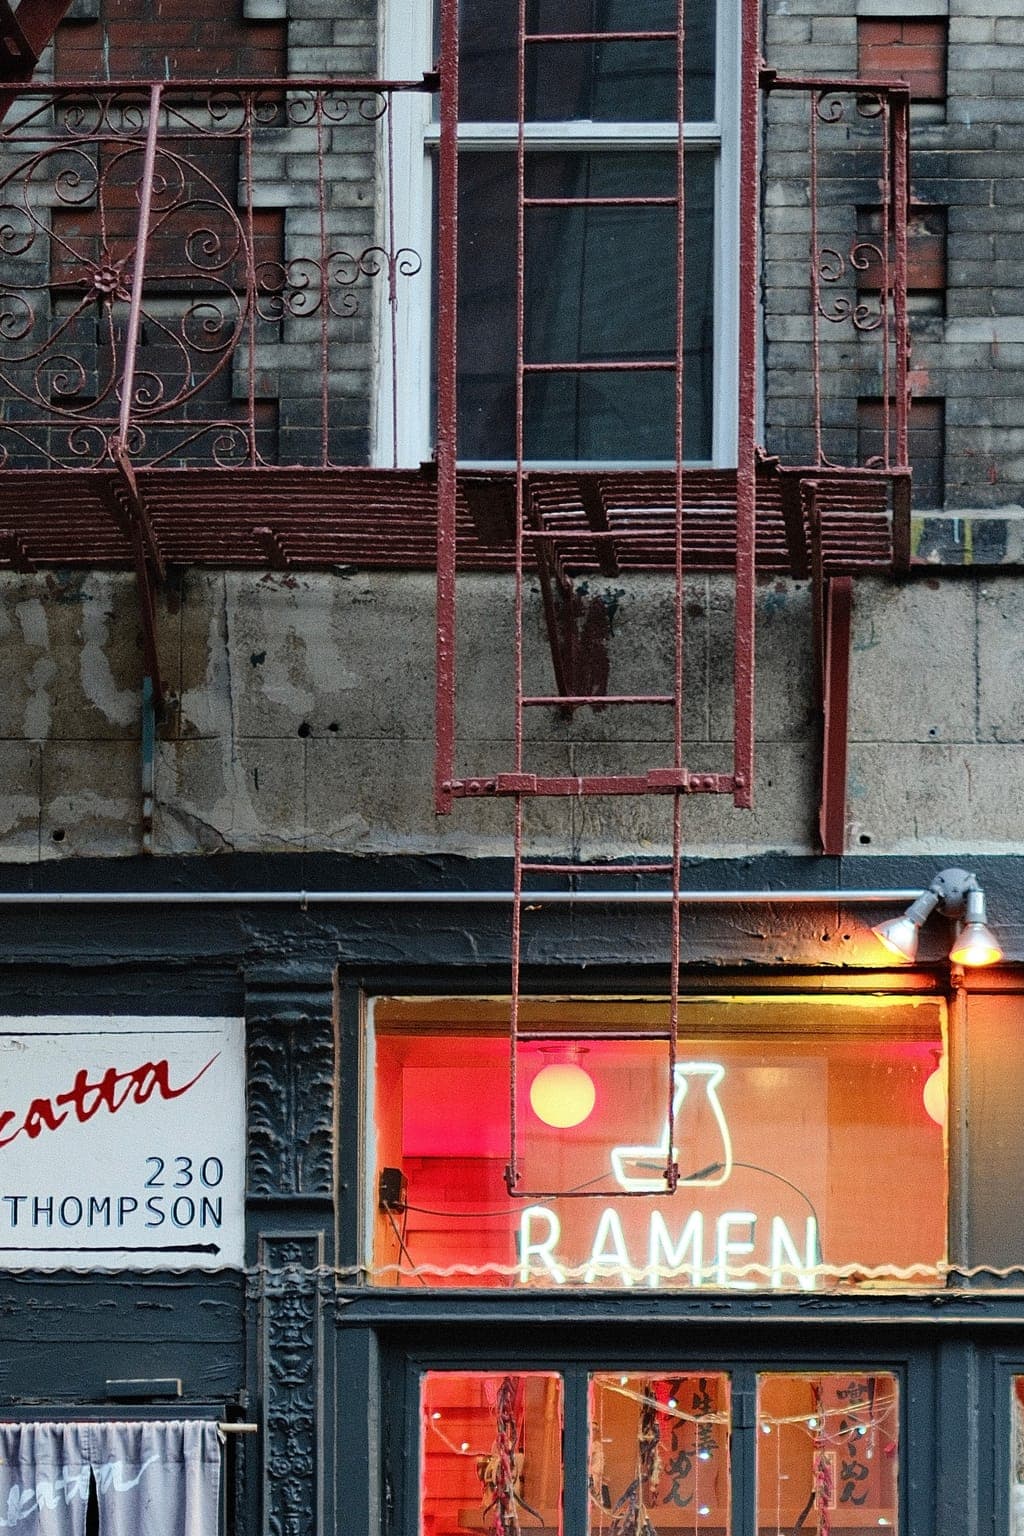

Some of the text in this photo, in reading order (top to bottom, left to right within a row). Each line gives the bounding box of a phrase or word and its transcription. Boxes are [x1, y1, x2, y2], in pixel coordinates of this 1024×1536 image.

[144, 1156, 225, 1190] 230
[2, 1195, 225, 1229] THOMPSON
[519, 1205, 820, 1291] RAMEN
